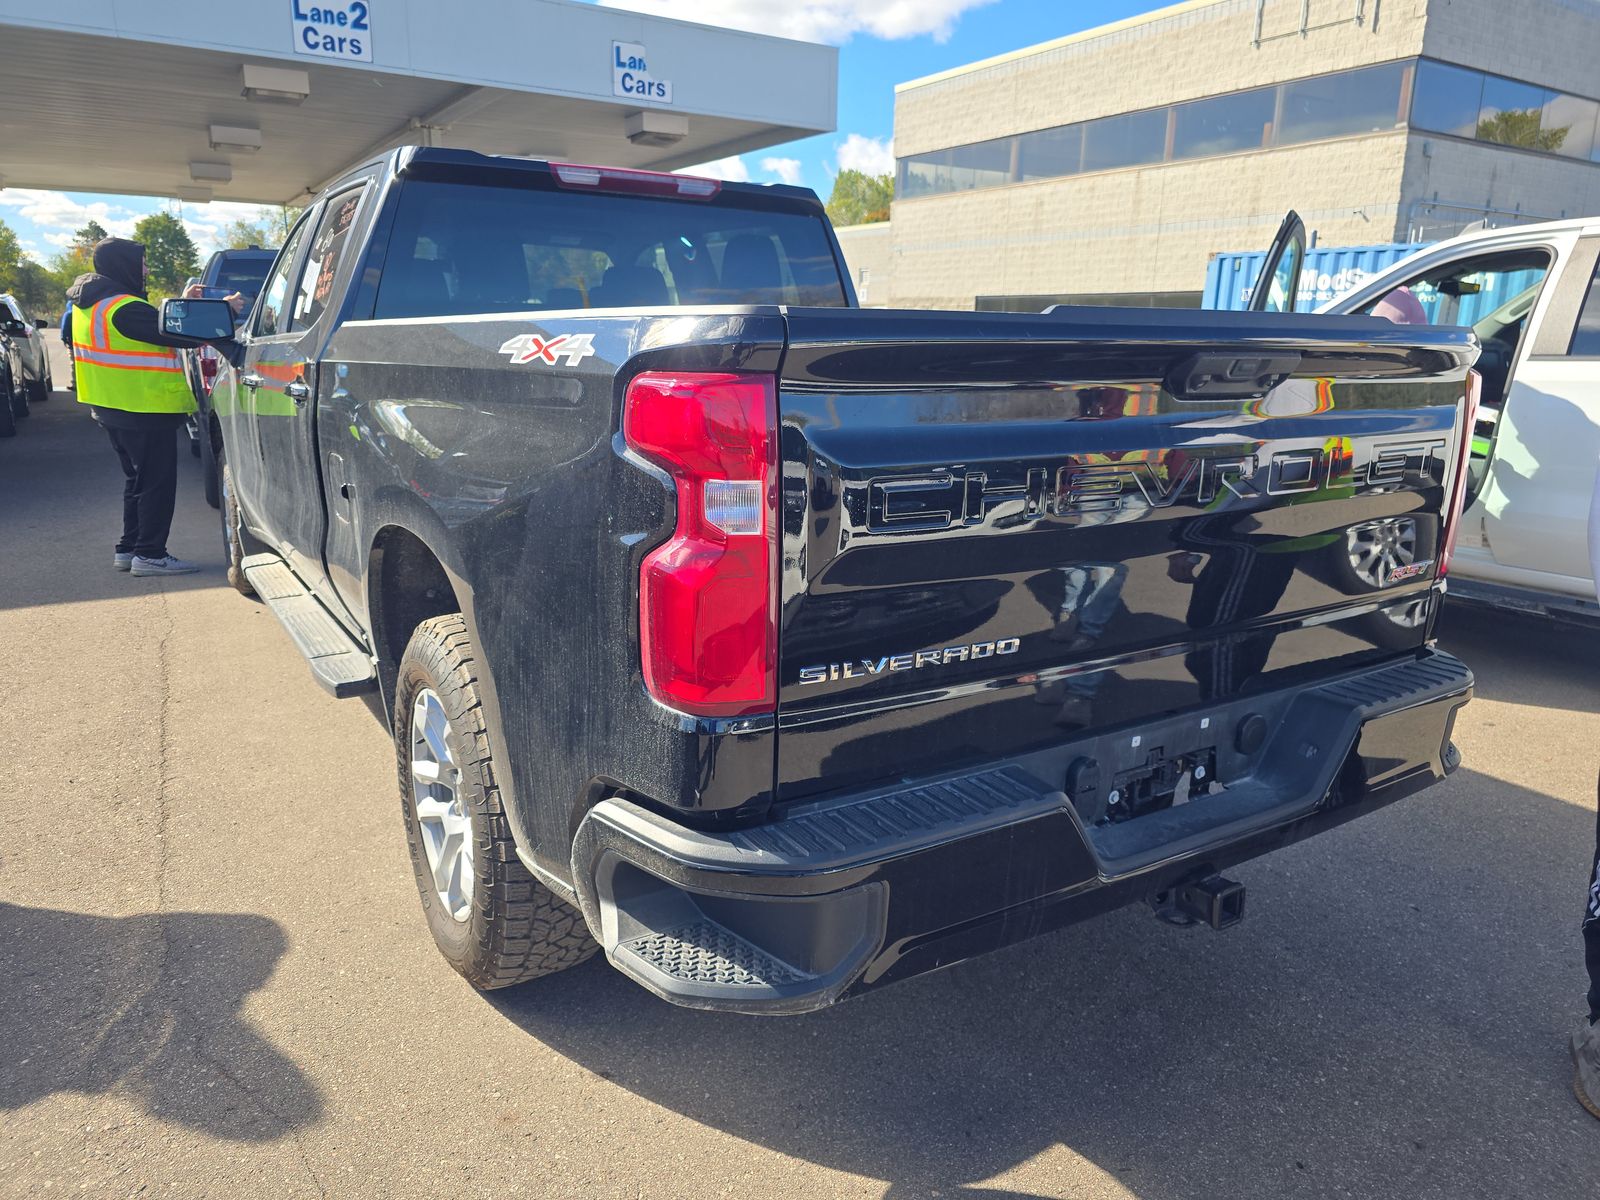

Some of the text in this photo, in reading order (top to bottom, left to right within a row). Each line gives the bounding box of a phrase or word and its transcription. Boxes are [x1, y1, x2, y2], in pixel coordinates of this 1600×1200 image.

[302, 26, 362, 55] Cars
[621, 72, 666, 97] Cars
[866, 438, 1446, 534] CHEVROLET
[799, 637, 1021, 686] SILVERADO
